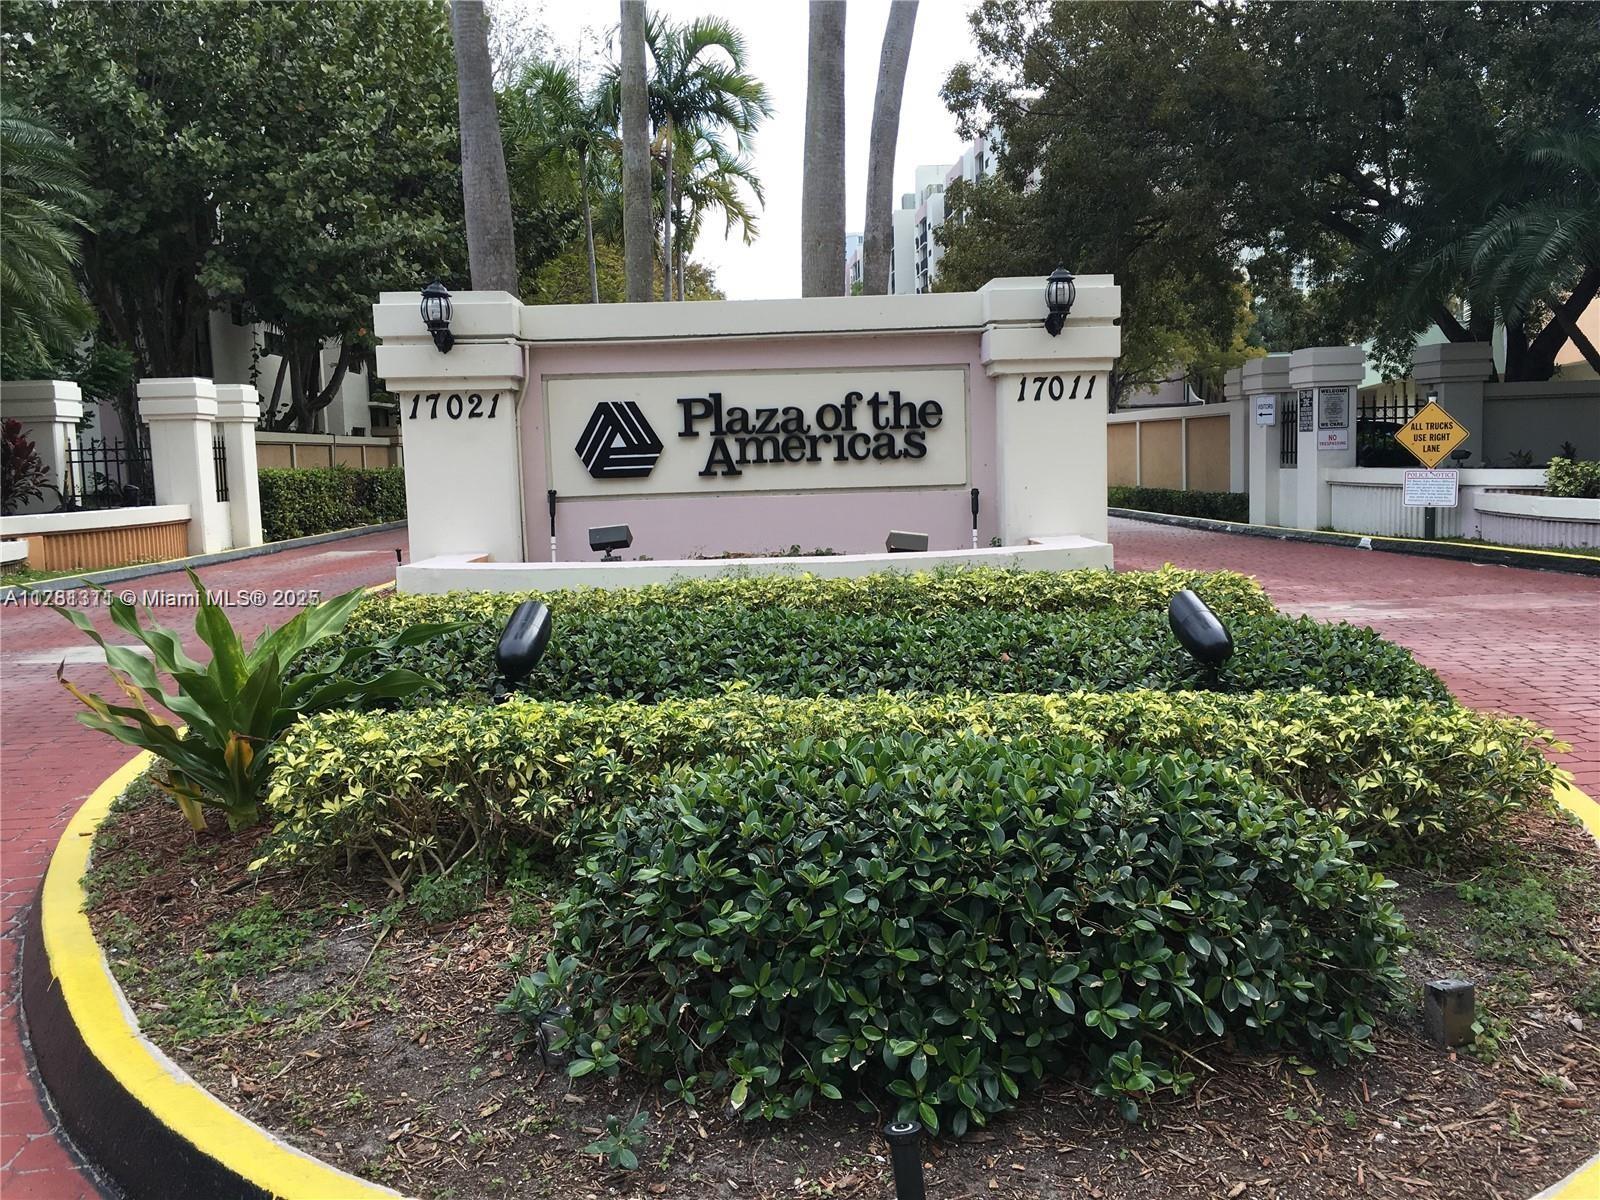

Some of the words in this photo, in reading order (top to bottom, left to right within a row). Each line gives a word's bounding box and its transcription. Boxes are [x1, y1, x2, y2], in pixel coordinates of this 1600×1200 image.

[1016, 375, 1096, 403] 17011
[408, 393, 501, 421] 17021
[677, 392, 811, 438] Plaza
[814, 391, 865, 432] of
[868, 390, 943, 430] the
[1410, 422, 1423, 431] ALL
[1425, 421, 1453, 430] TRUCKS
[1413, 434, 1427, 442] USE
[1429, 432, 1450, 442] RIGHT
[698, 427, 928, 477] Americas
[1422, 444, 1441, 453] LANE
